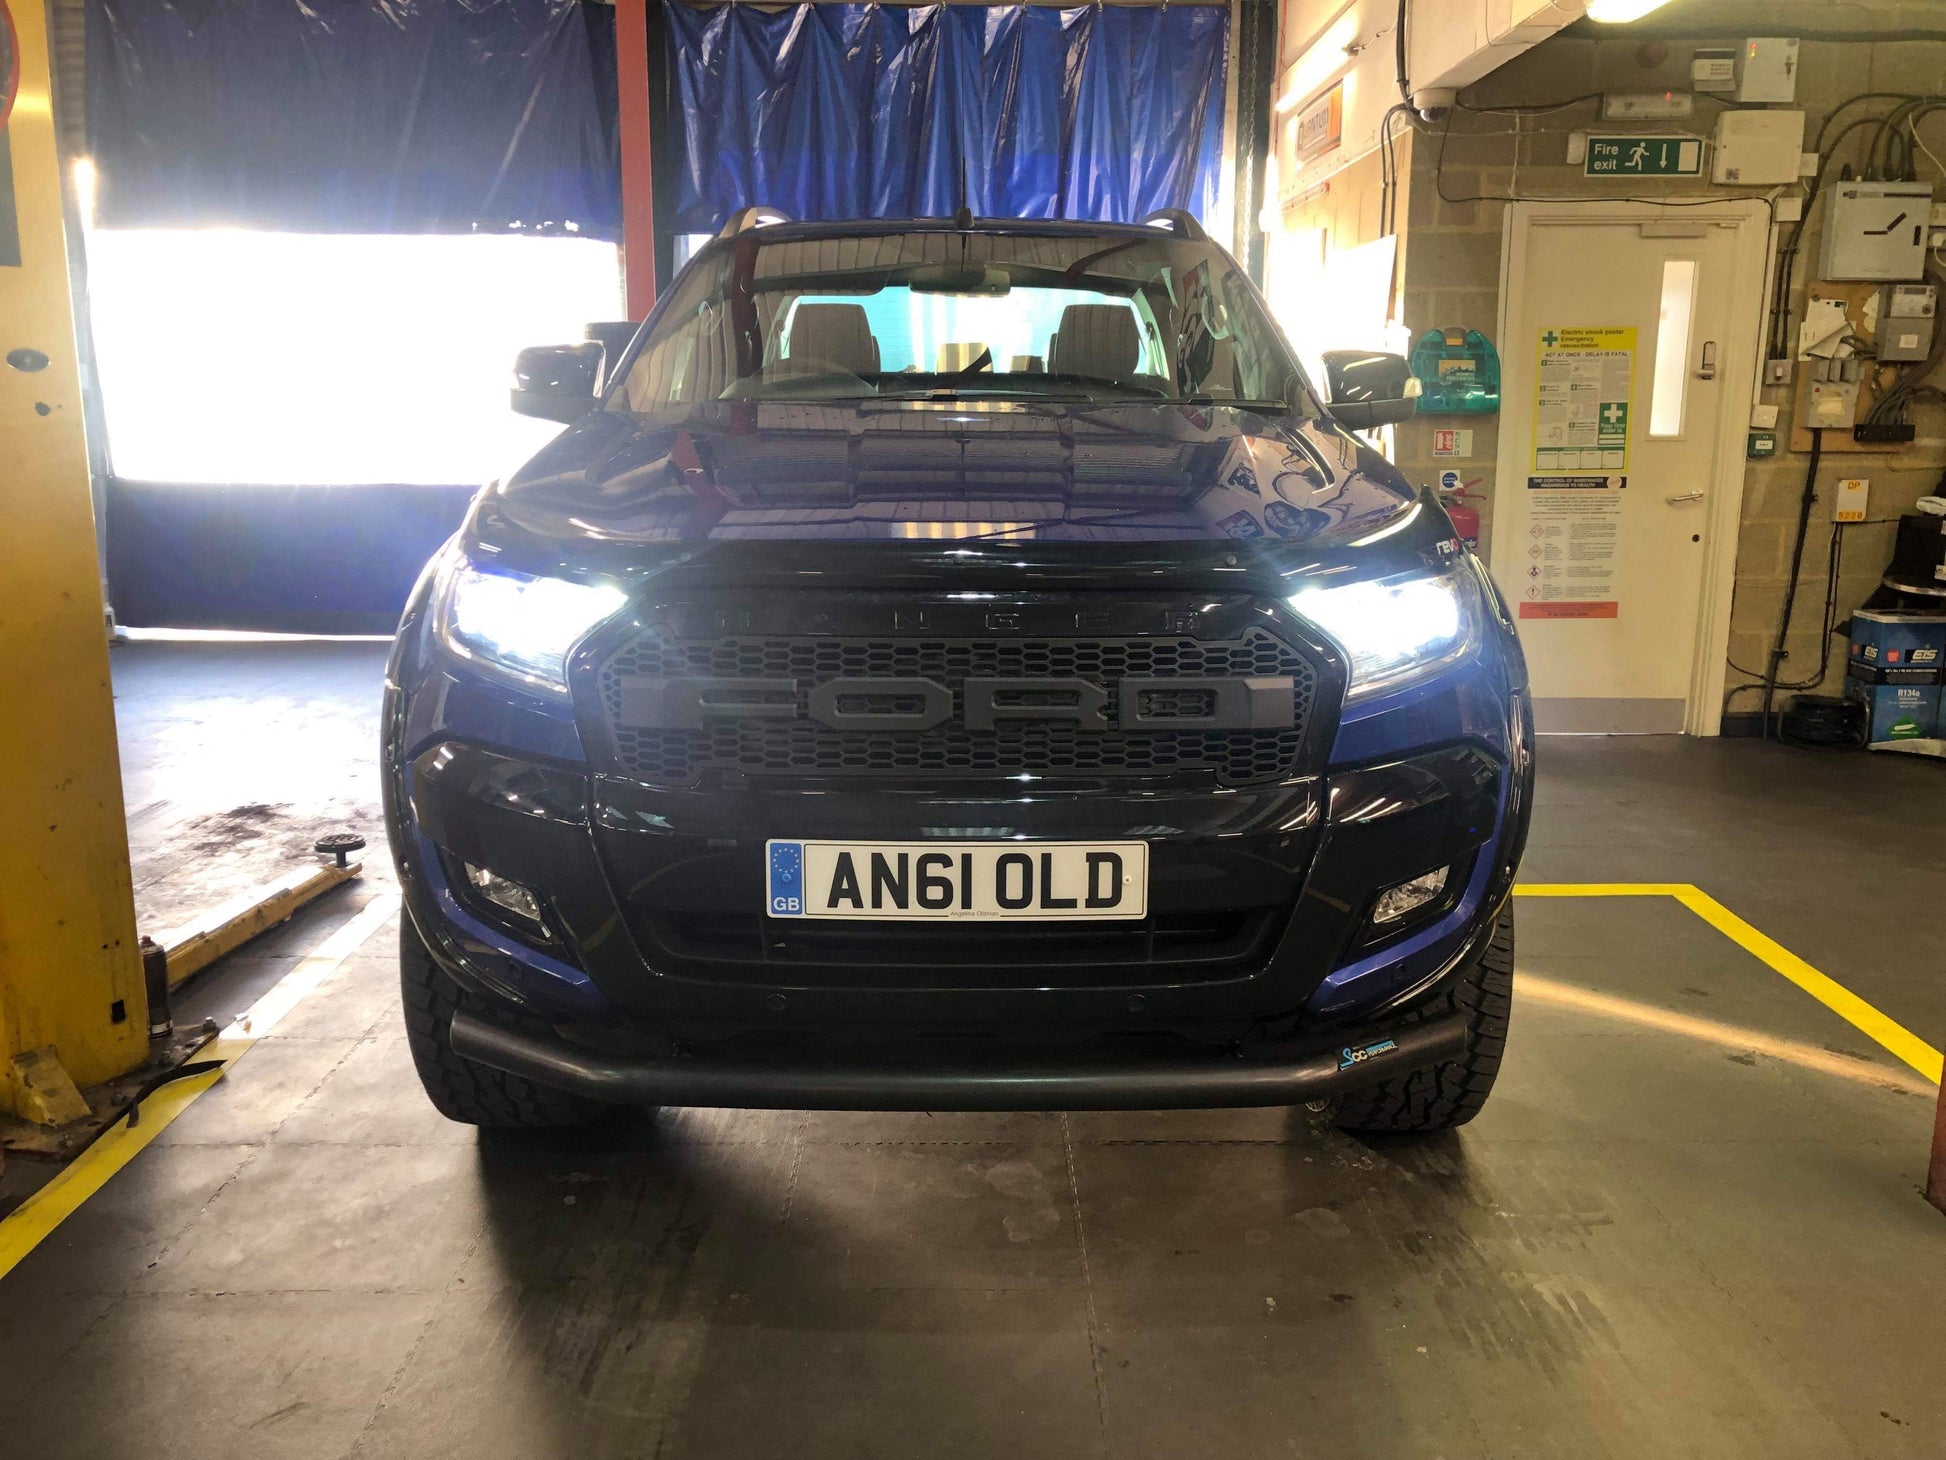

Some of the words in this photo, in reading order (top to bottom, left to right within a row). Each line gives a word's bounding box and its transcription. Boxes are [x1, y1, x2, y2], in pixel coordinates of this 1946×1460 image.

[1595, 144, 1619, 155] Fire
[1594, 159, 1617, 170] exit
[1912, 649, 1938, 660] EIS
[1898, 689, 1920, 697] R134a
[621, 677, 1295, 730] FORD
[827, 851, 972, 910] AN61
[996, 851, 1124, 909] OLD
[773, 897, 800, 912] GB
[950, 910, 976, 918] Angelina
